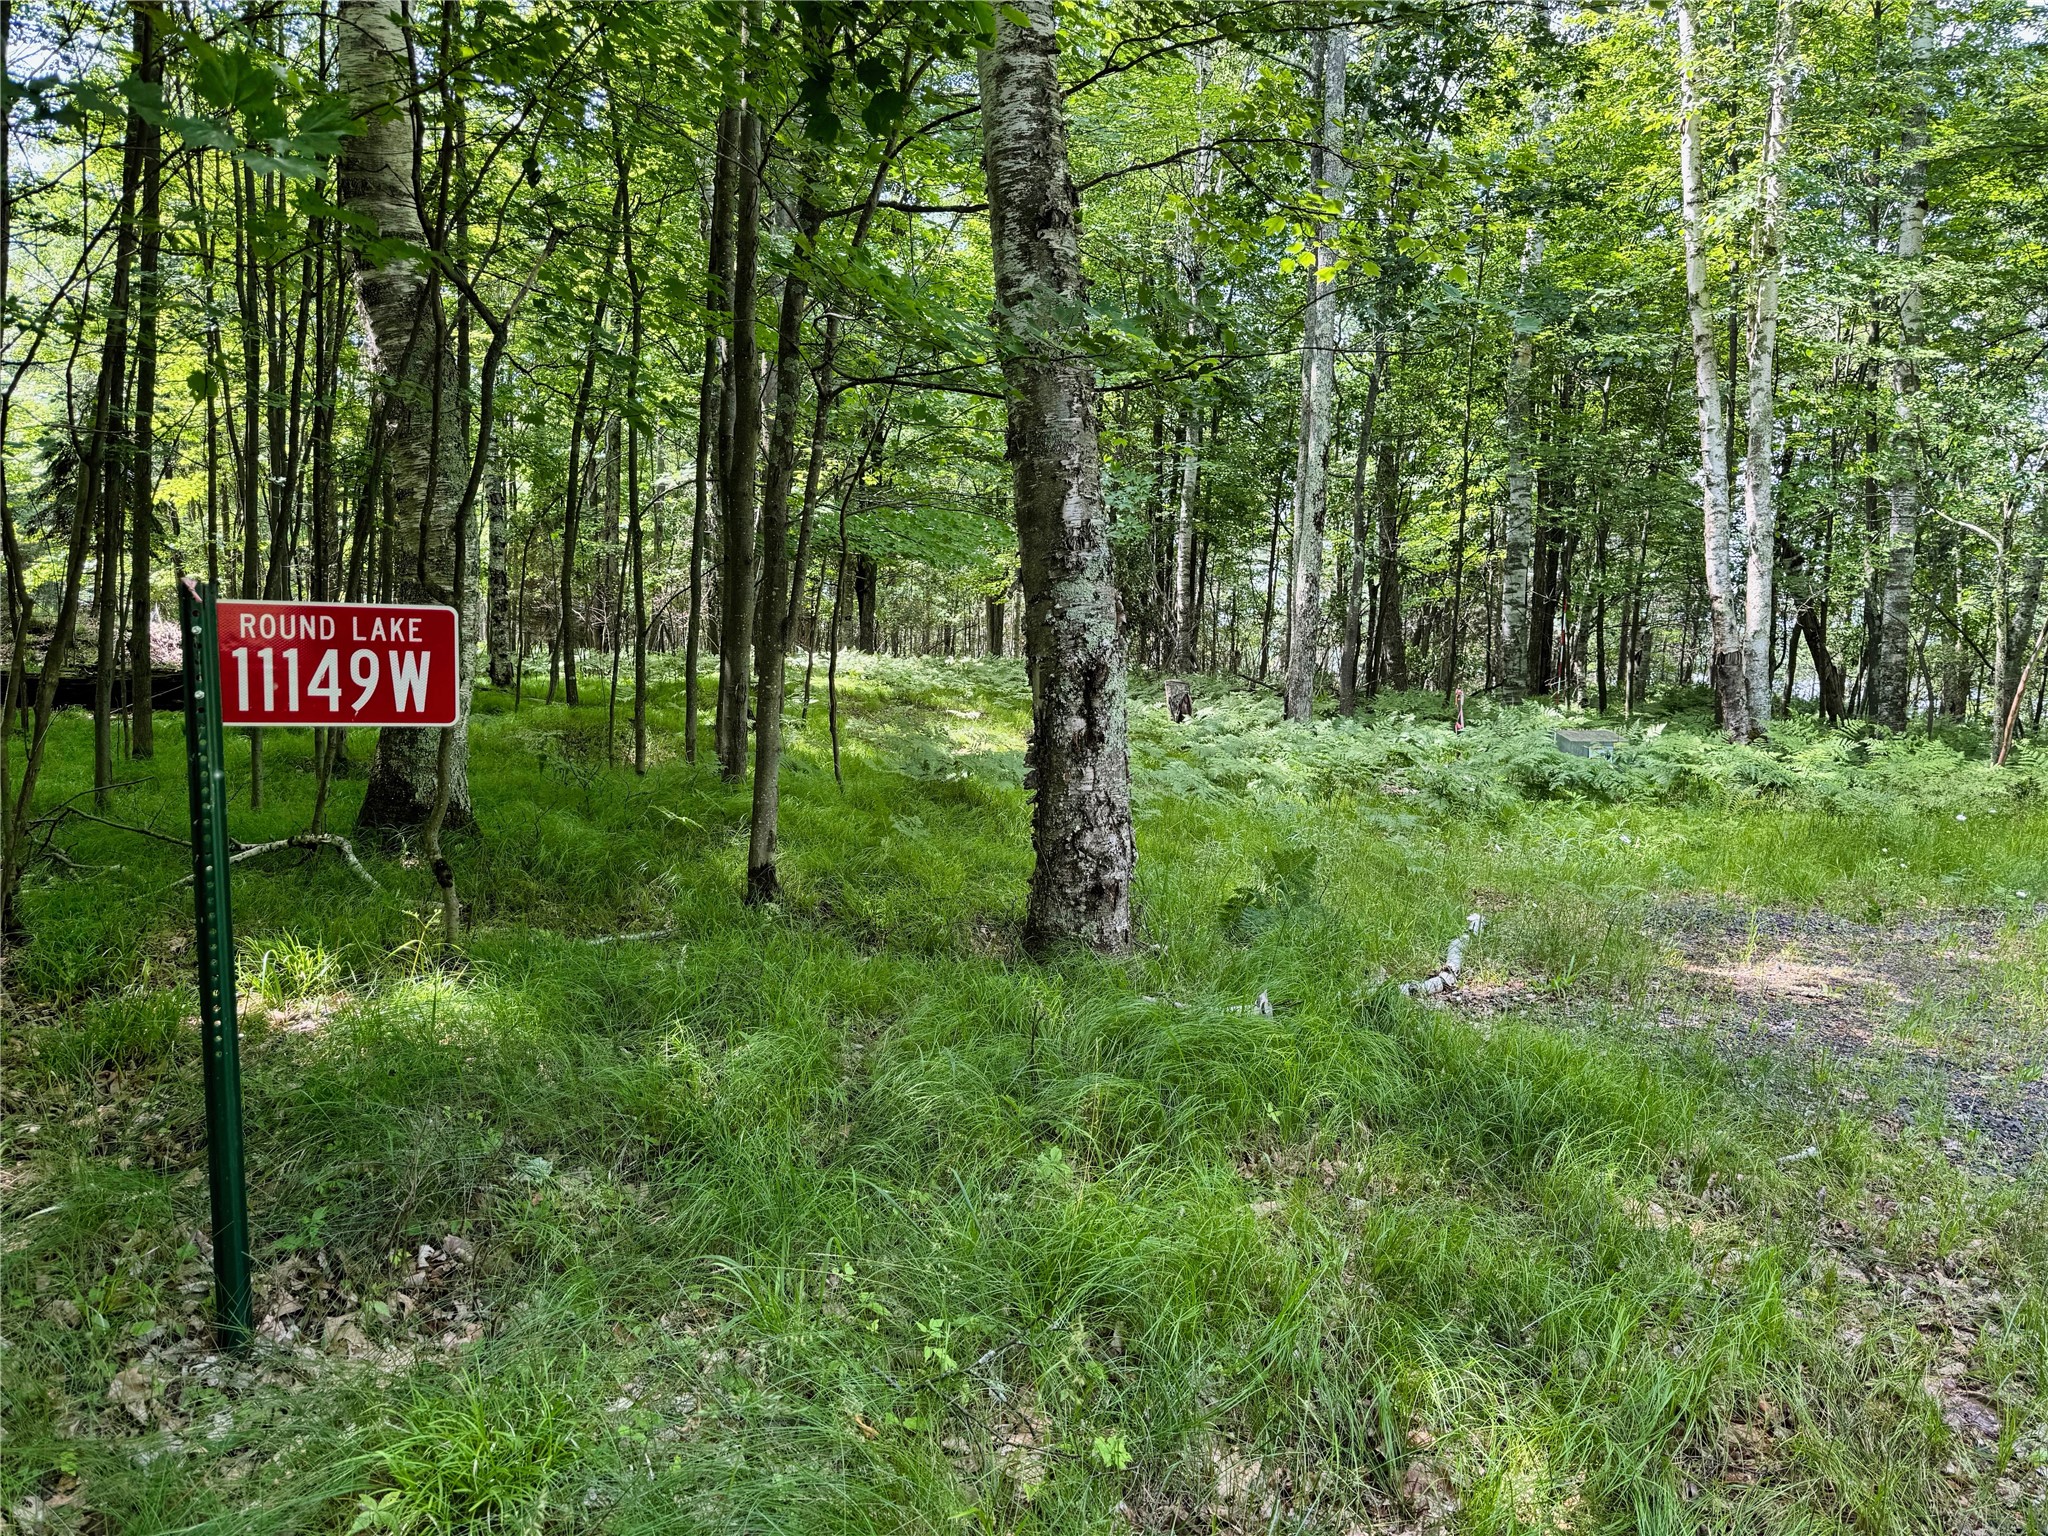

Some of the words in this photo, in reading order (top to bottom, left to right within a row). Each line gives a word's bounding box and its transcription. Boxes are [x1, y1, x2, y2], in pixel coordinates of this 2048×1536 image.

[239, 613, 335, 641] ROUND
[352, 616, 423, 643] LAKE
[232, 646, 431, 713] 11149W
